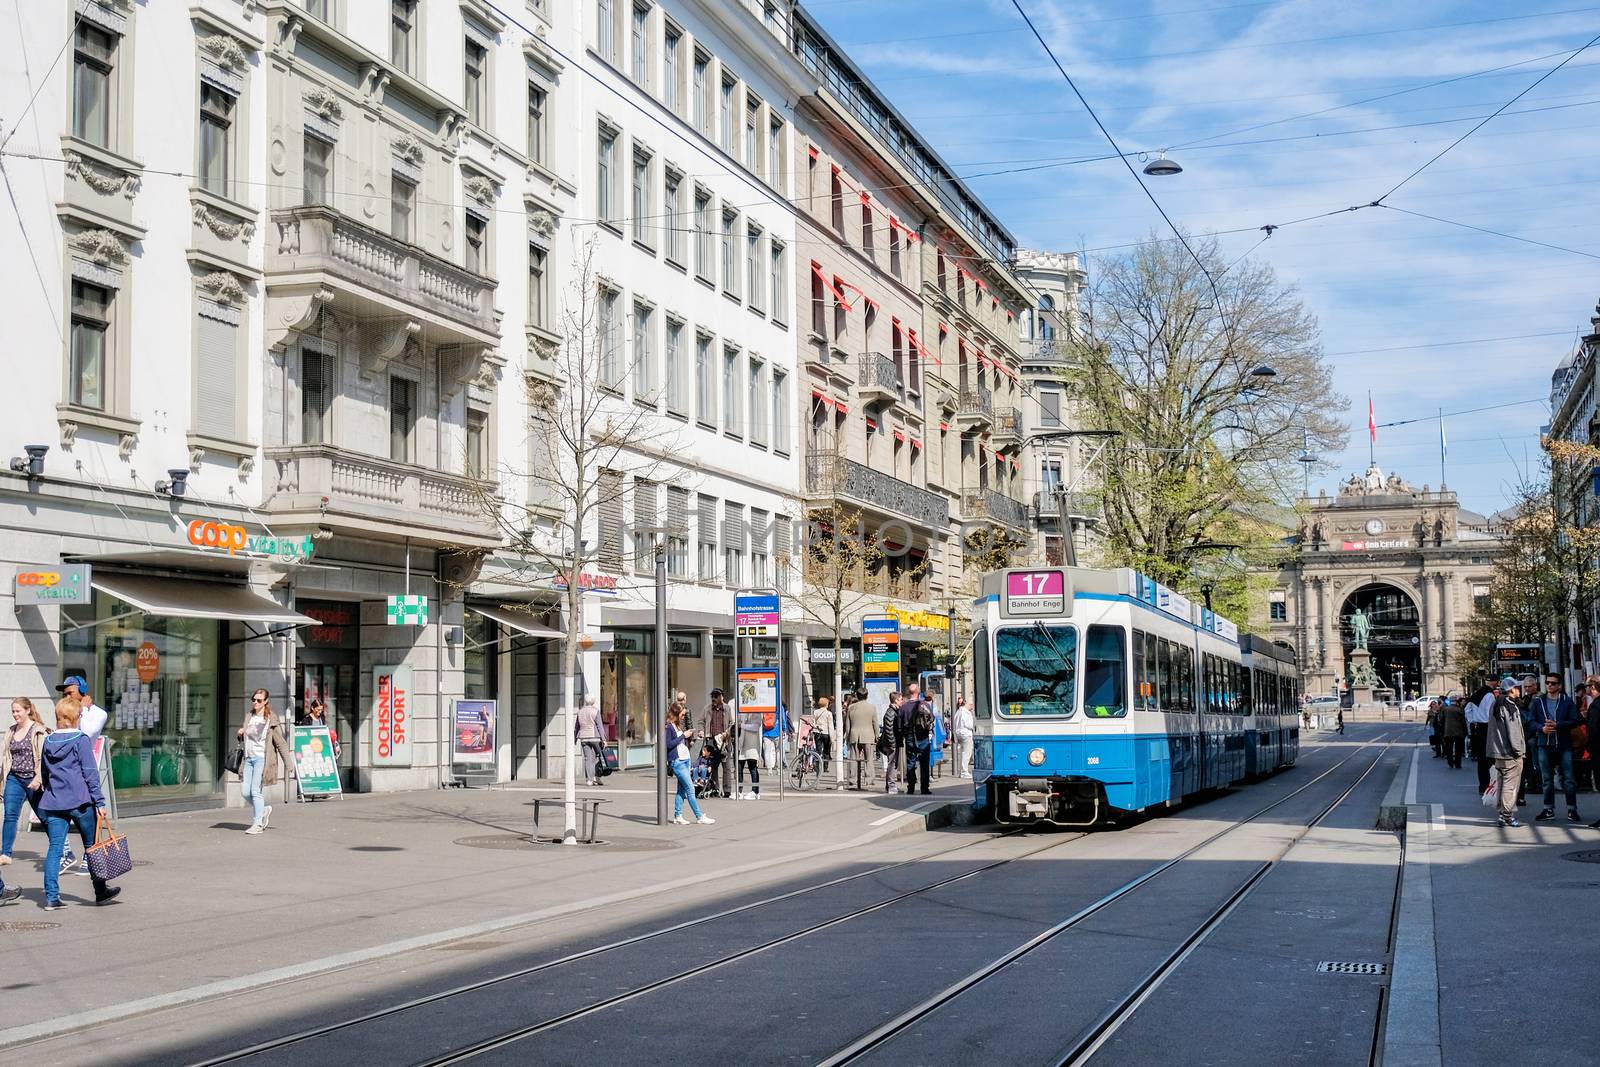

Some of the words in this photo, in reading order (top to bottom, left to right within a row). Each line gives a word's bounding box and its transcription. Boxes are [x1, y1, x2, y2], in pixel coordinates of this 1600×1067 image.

[187, 519, 247, 556] coop
[248, 536, 299, 560] vitality
[17, 573, 60, 588] coop
[1022, 573, 1049, 594] 17
[36, 587, 79, 600] vitality
[1043, 600, 1061, 609] Enge
[138, 648, 158, 660] 20%
[378, 674, 391, 758] OCHSNER
[392, 687, 406, 745] SPORT
